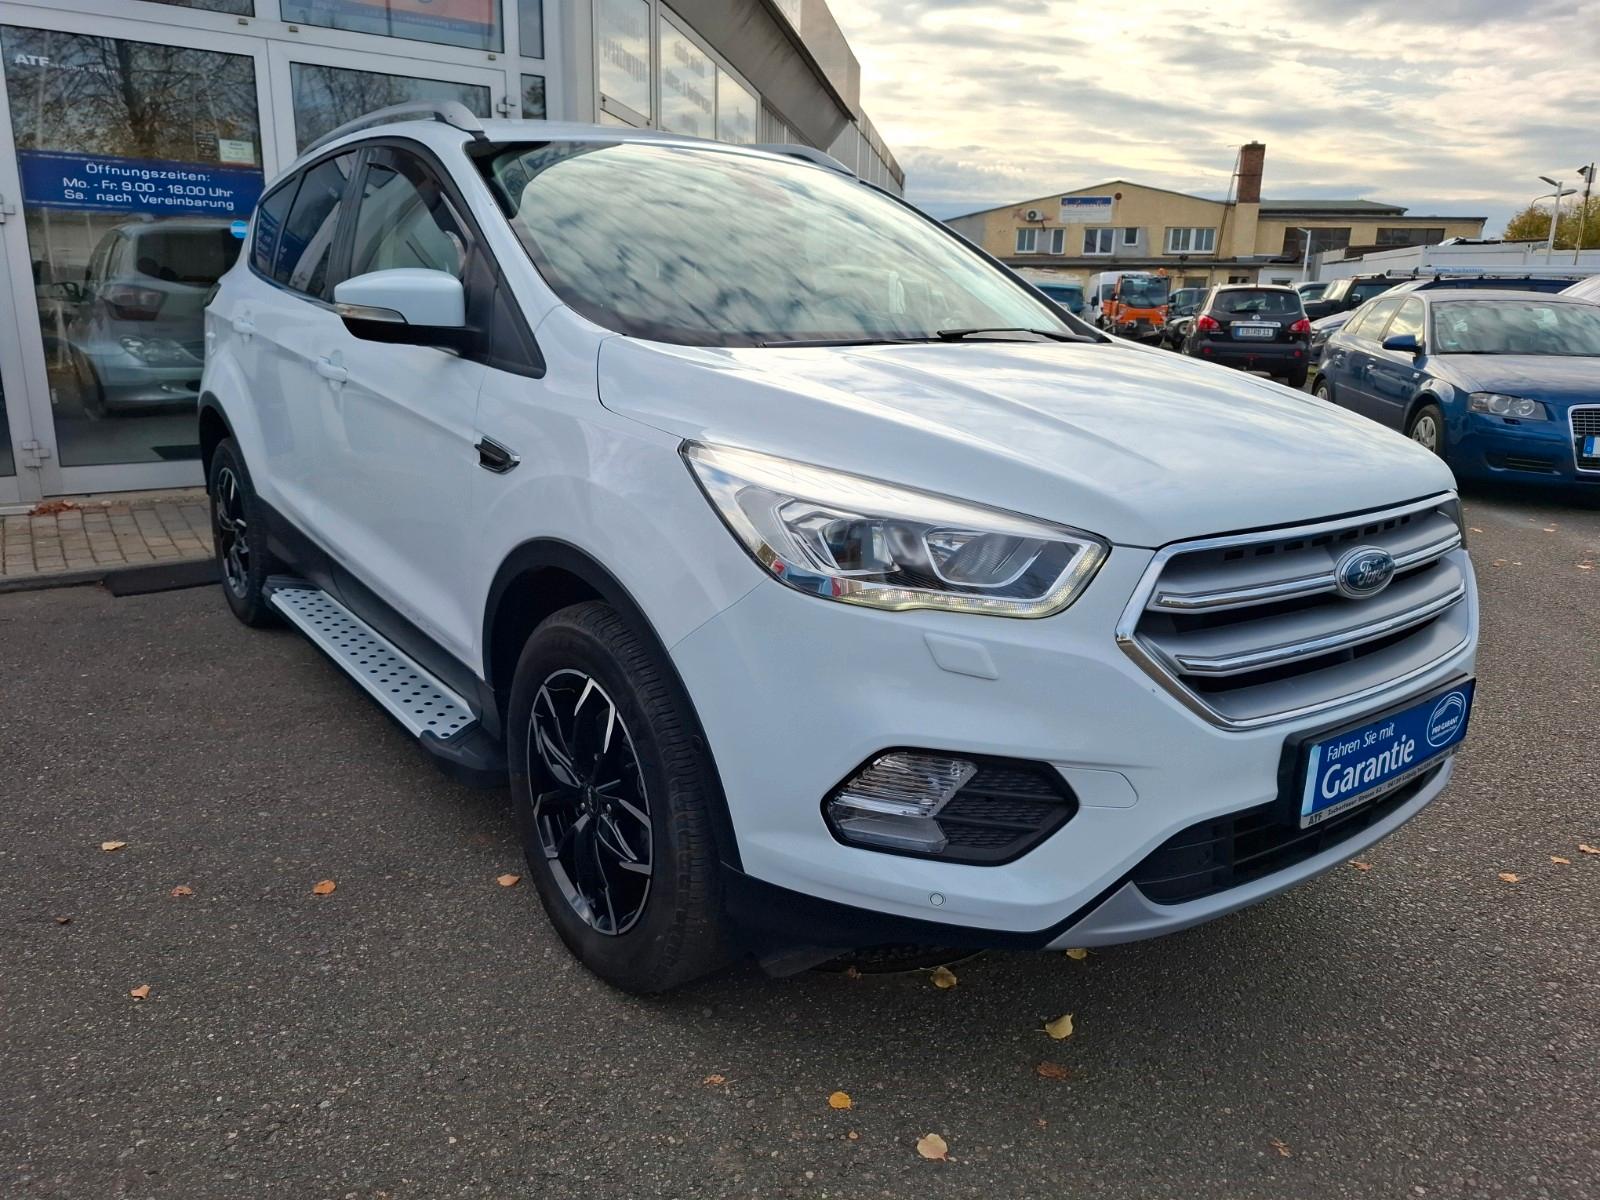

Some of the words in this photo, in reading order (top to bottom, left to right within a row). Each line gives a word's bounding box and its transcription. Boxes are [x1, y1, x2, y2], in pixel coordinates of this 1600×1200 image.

[15, 54, 49, 66] ATF
[86, 162, 211, 182] Öffnungszeiten:
[63, 177, 91, 189] Mo.
[102, 180, 118, 190] Fr.
[121, 181, 155, 193] 9.00
[167, 184, 206, 196] 18.00
[209, 187, 234, 198] Uhr
[64, 189, 88, 200] Sa.
[96, 193, 132, 203] nach
[139, 194, 235, 211] Vereinbarung
[1357, 560, 1387, 586] Ford
[1327, 739, 1360, 762] Fahren
[1363, 730, 1378, 748] Sie
[1379, 721, 1395, 741] mit
[1321, 734, 1415, 799] Garantie
